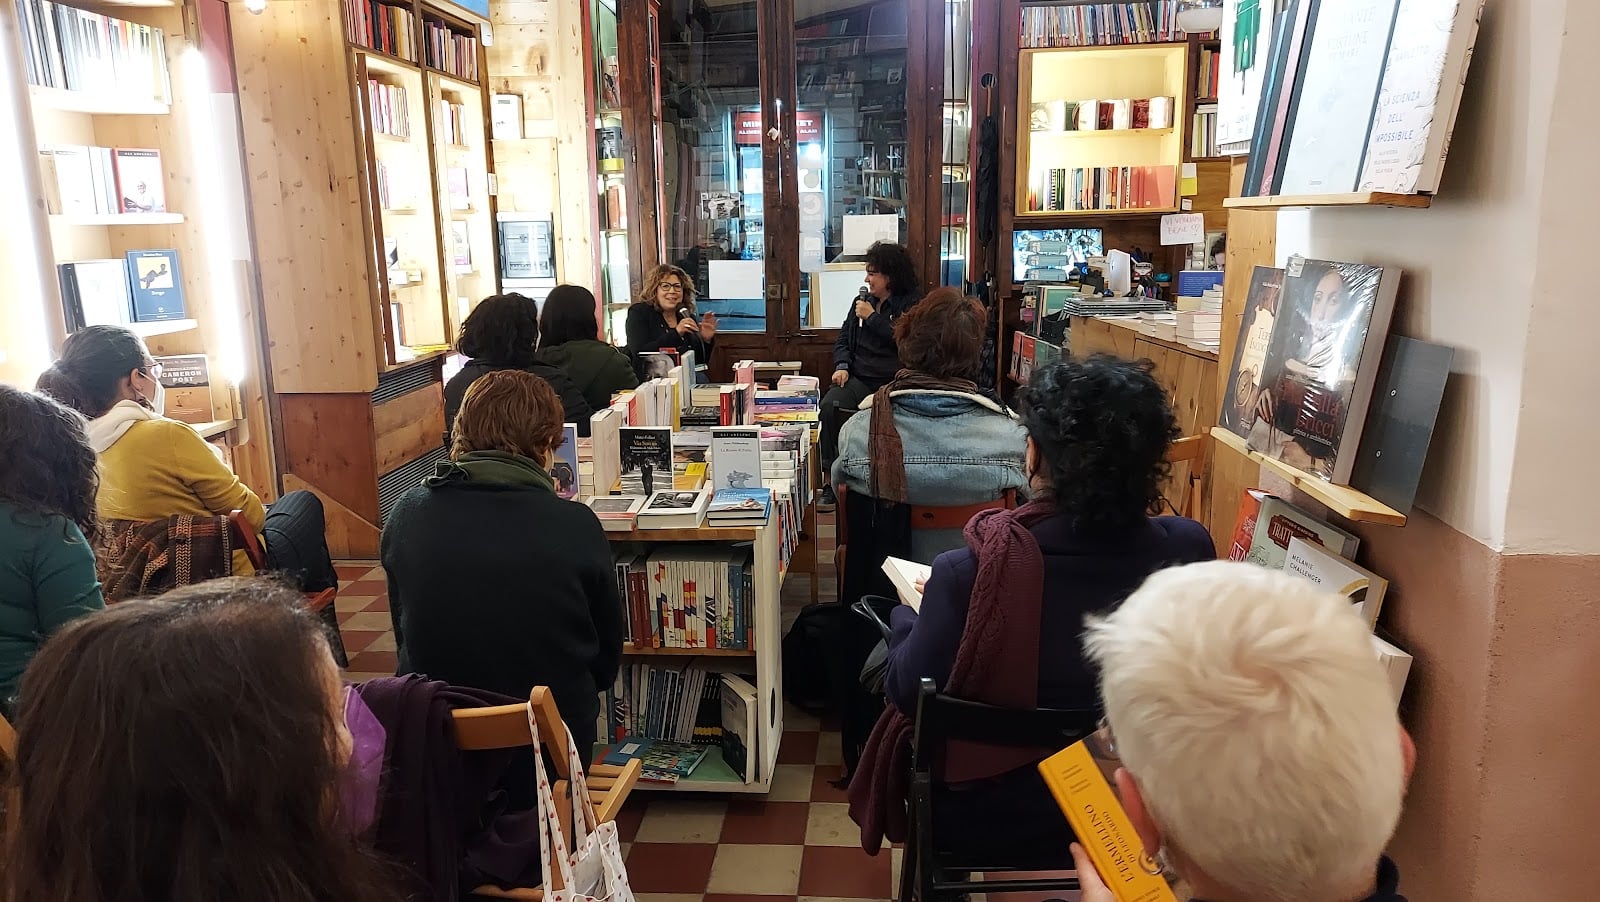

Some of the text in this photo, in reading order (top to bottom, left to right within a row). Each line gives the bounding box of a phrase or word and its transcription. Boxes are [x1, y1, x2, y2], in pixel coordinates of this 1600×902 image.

[1391, 91, 1421, 105] SCIENZA
[1375, 129, 1414, 143] MPOSSIBILE
[162, 370, 202, 378] CAMERON
[1292, 554, 1314, 571] MELANIE
[1289, 562, 1322, 585] CHALLENGER
[1083, 803, 1136, 883] L'ERMELLINO
